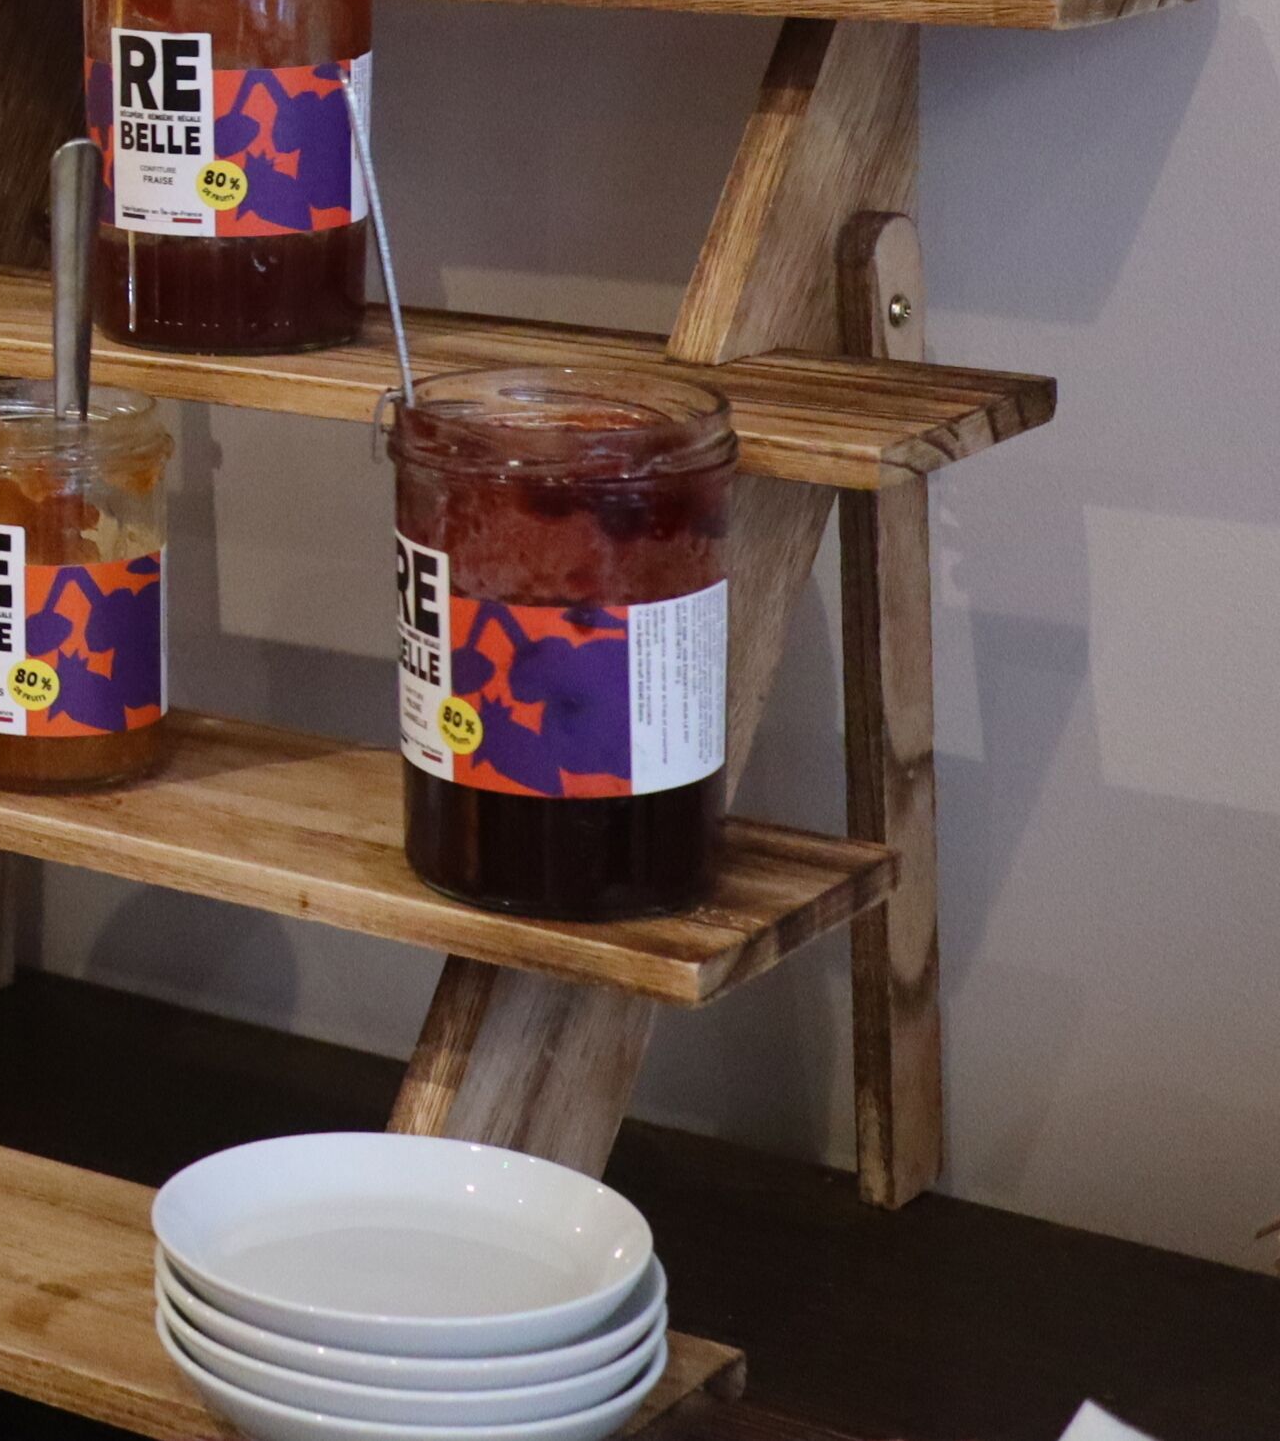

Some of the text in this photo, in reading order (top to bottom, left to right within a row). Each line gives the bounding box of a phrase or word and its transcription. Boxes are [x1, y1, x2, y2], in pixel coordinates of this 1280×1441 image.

[119, 35, 201, 112] RE
[121, 120, 201, 155] BELLE
[140, 165, 176, 174] CONFITURE
[143, 175, 174, 185] FRAISE
[396, 536, 439, 638] RE
[401, 637, 440, 686] ELLE
